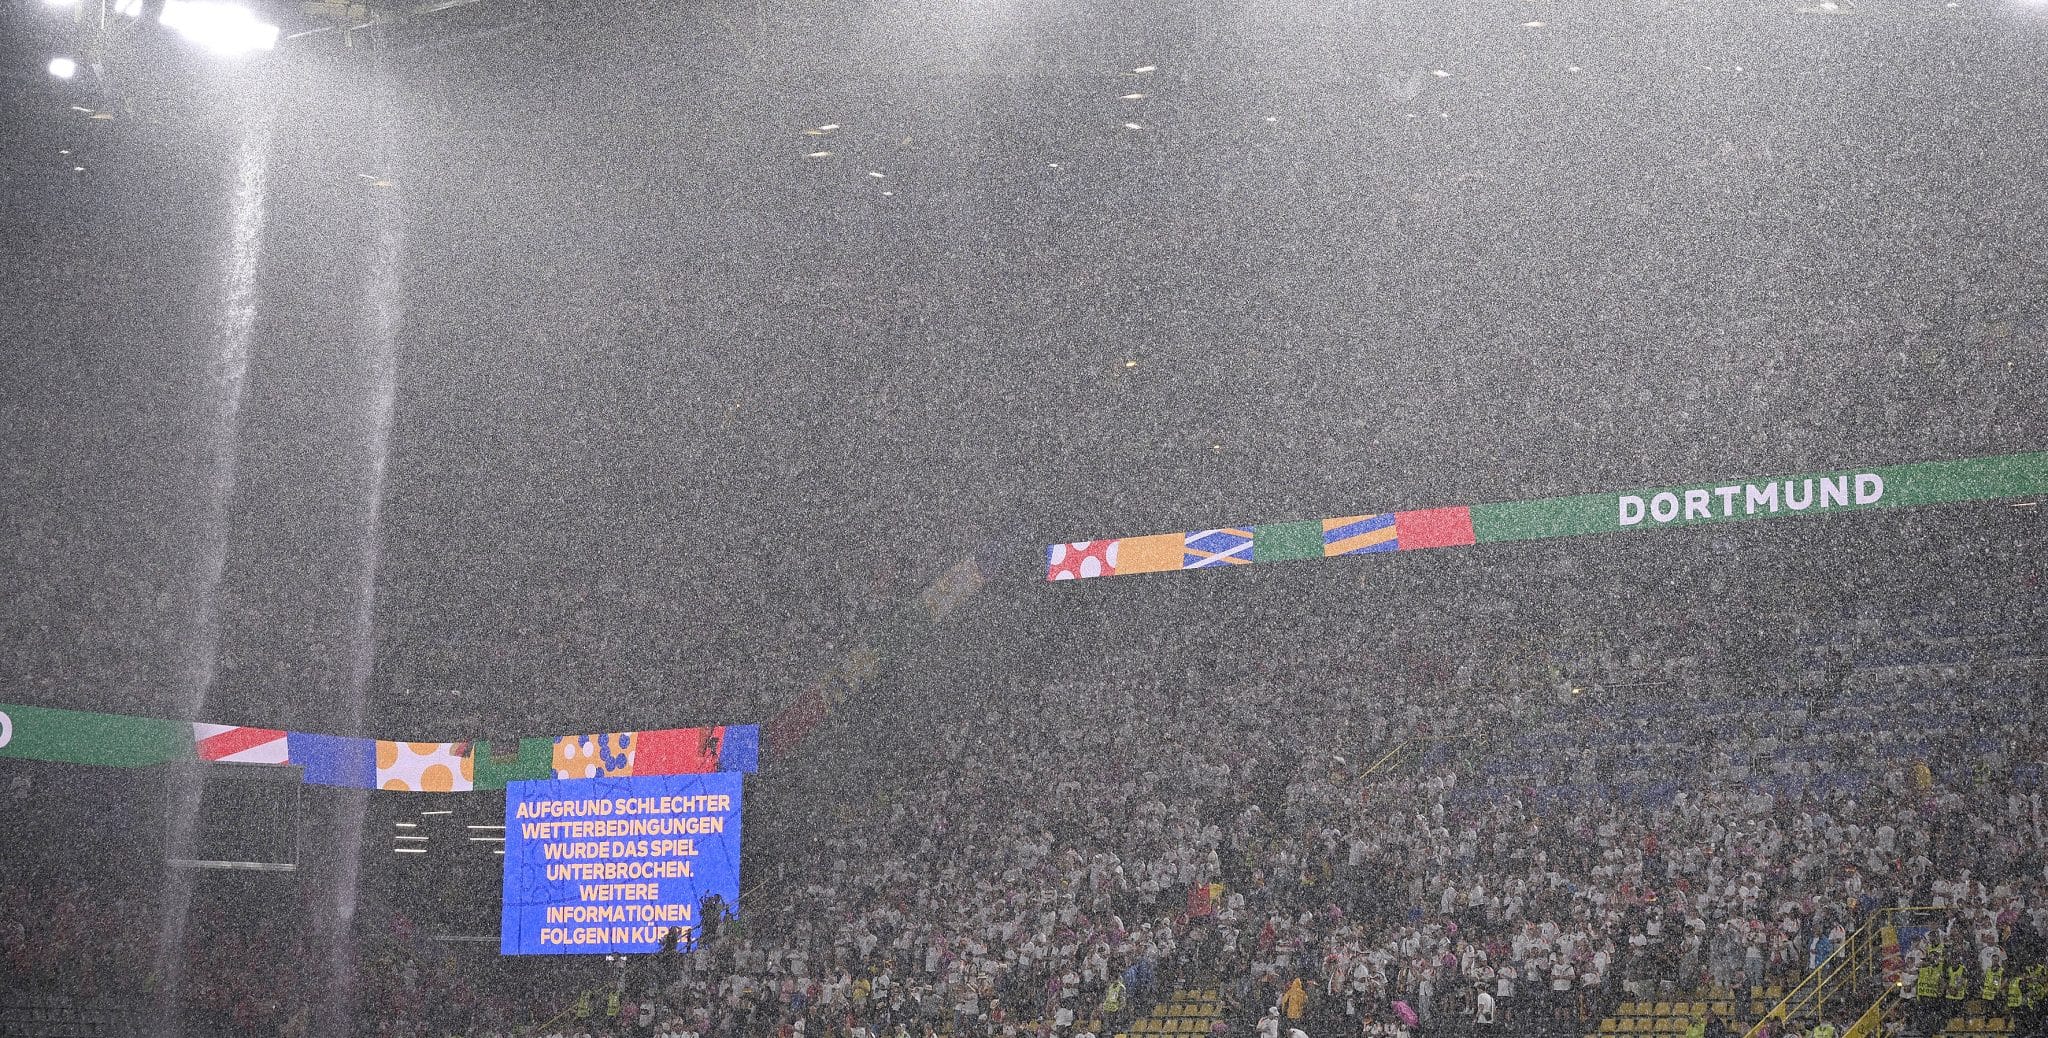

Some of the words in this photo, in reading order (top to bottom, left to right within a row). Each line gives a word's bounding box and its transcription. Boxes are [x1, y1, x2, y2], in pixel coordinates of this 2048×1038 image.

[1619, 473, 1884, 526] DORTMUND
[516, 799, 613, 819] AUFGRUND
[615, 795, 730, 815] SCHLECHTER
[522, 817, 724, 839] WETTERBEDINGUNGEN
[544, 842, 610, 860] WURDE
[613, 841, 649, 858] DAS
[650, 839, 699, 857] SPIEL
[546, 861, 694, 880] UNTERBROCHEN.
[580, 883, 659, 901] WEITERE
[546, 904, 691, 923] INFORMATIONEN
[540, 927, 609, 945] FOLGEN
[611, 927, 629, 944] IN
[632, 921, 696, 943] KÜRE.
